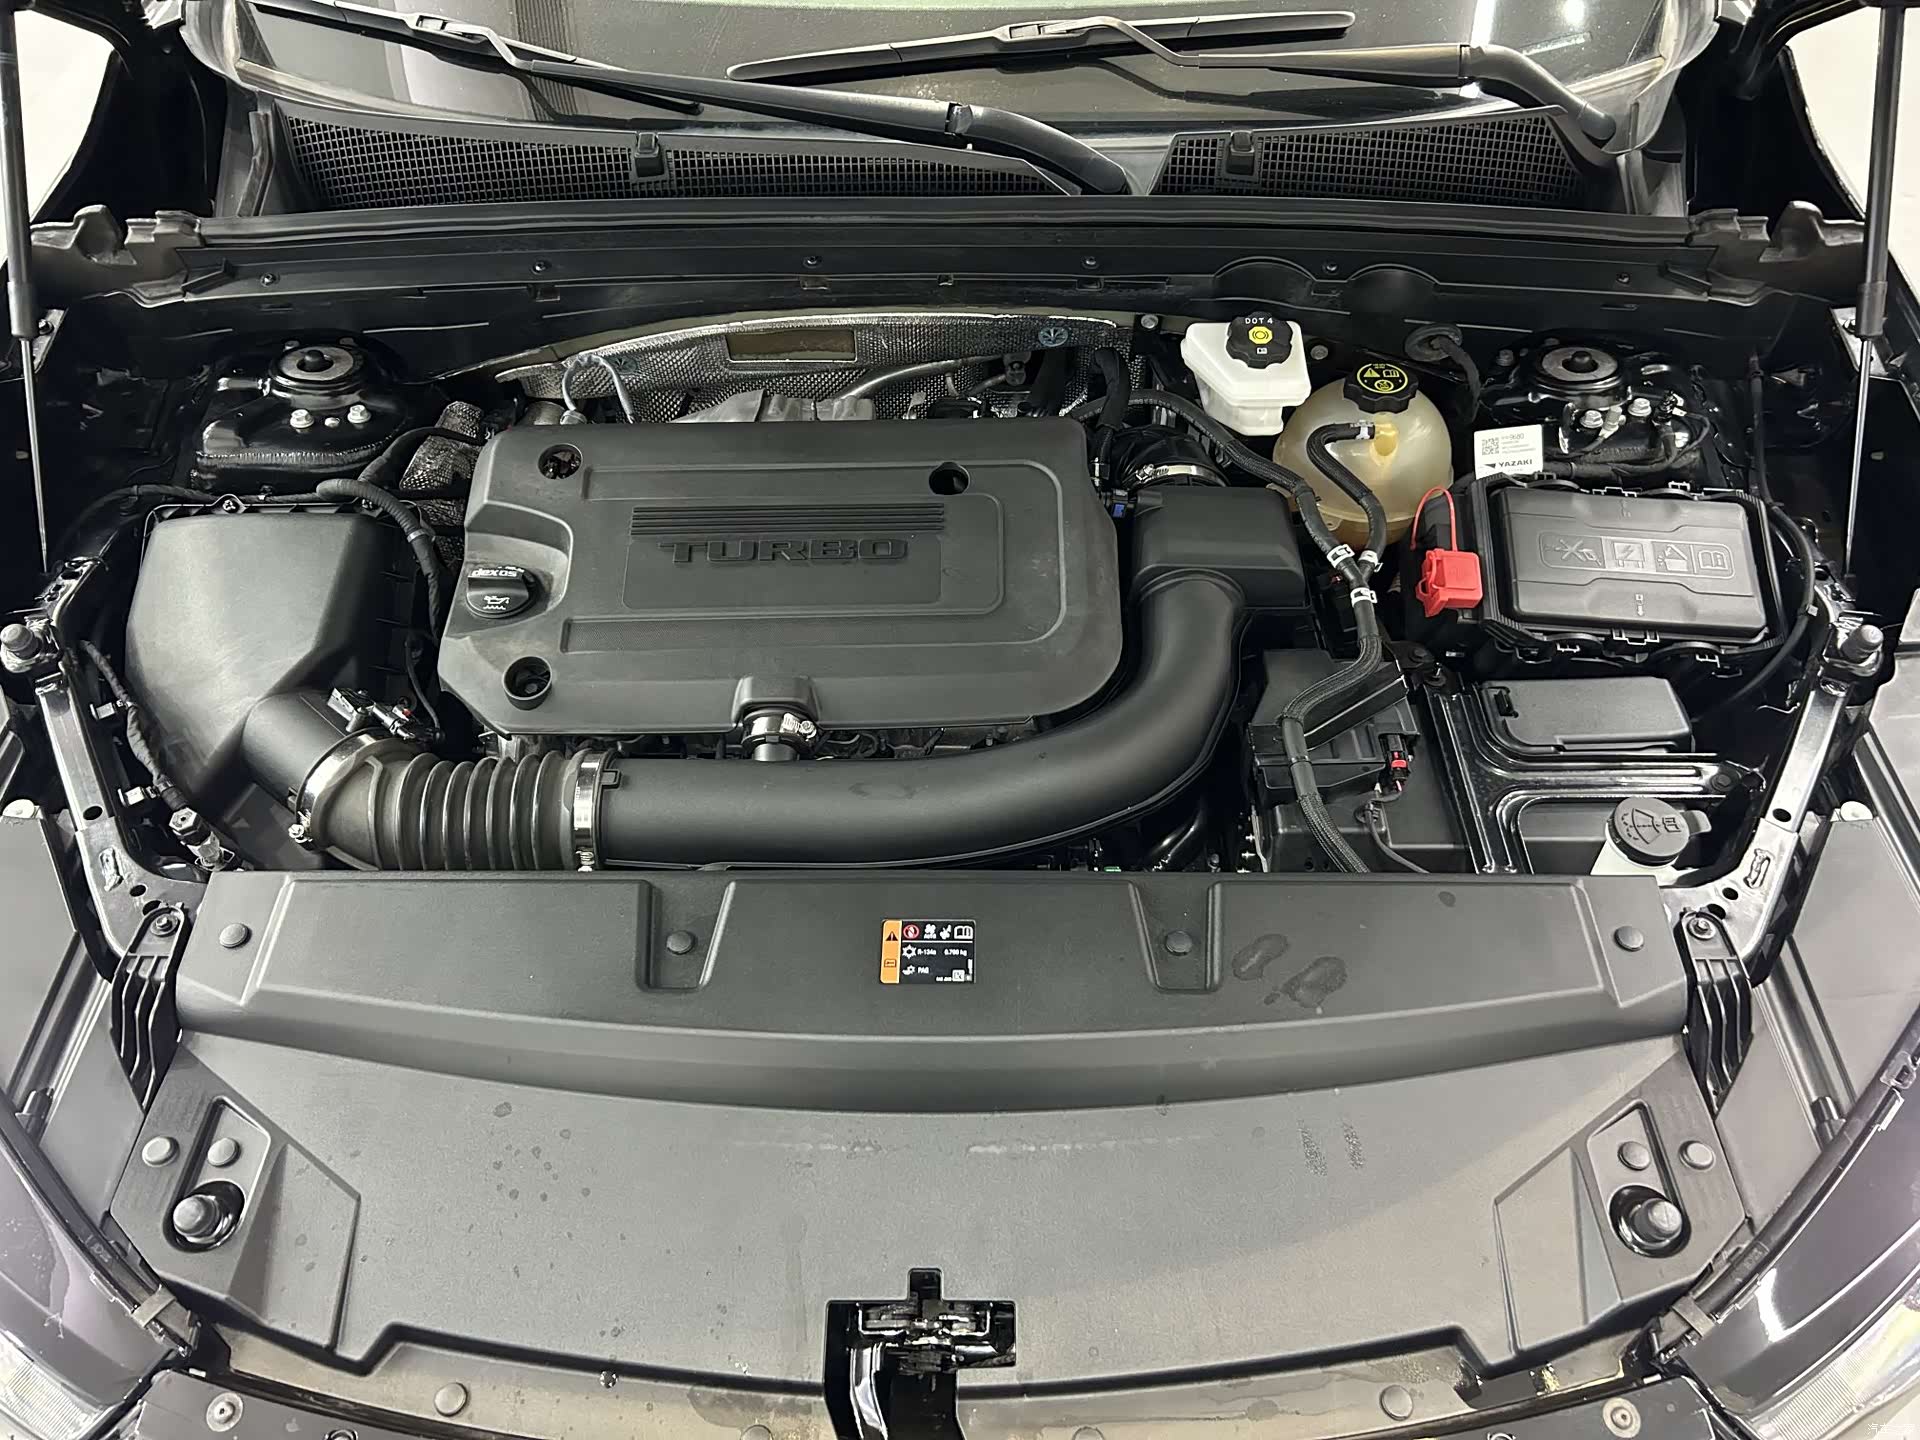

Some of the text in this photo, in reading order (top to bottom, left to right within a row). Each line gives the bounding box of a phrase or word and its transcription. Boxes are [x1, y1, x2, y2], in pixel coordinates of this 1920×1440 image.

[1498, 459, 1533, 467] YAZAKI
[658, 538, 909, 564] TURBO
[472, 568, 518, 577] dexos
